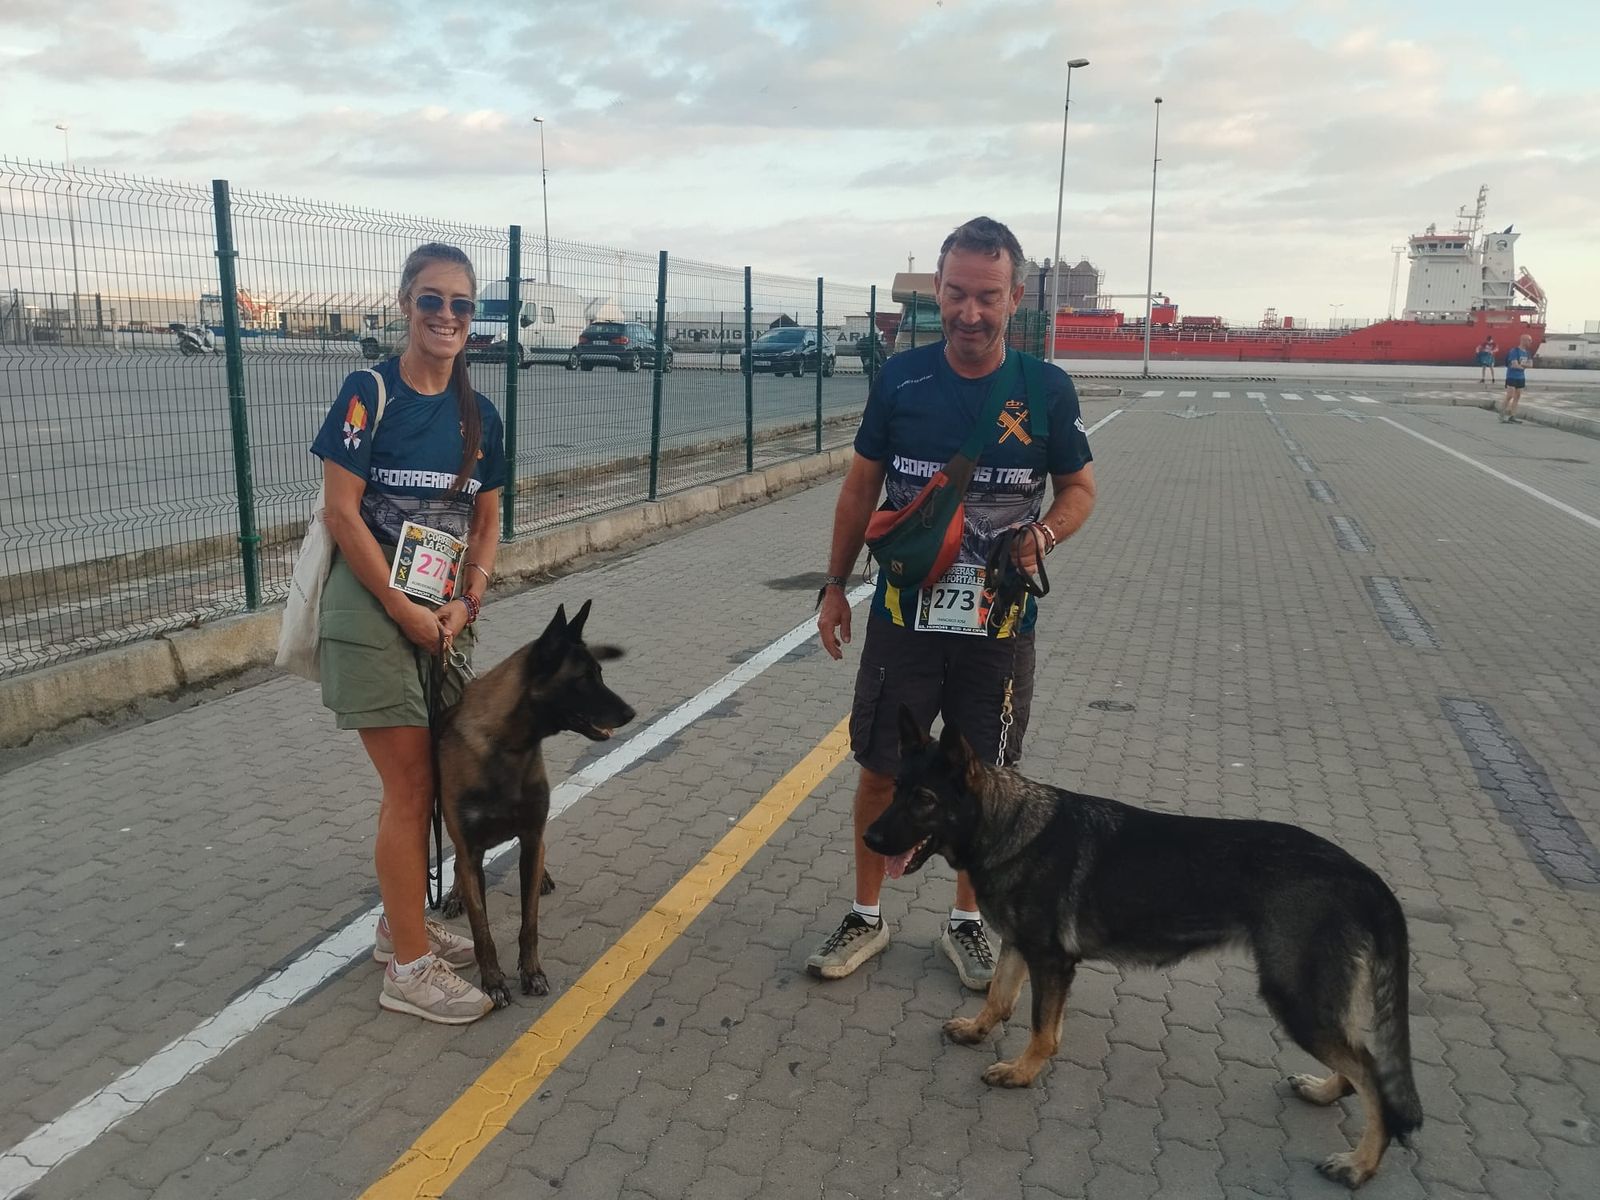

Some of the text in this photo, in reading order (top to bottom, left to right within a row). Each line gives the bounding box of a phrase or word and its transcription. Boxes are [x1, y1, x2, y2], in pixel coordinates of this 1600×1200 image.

[996, 468, 1033, 484] TRAIL
[946, 575, 985, 586] FORTALEZ
[934, 589, 975, 611] 273
